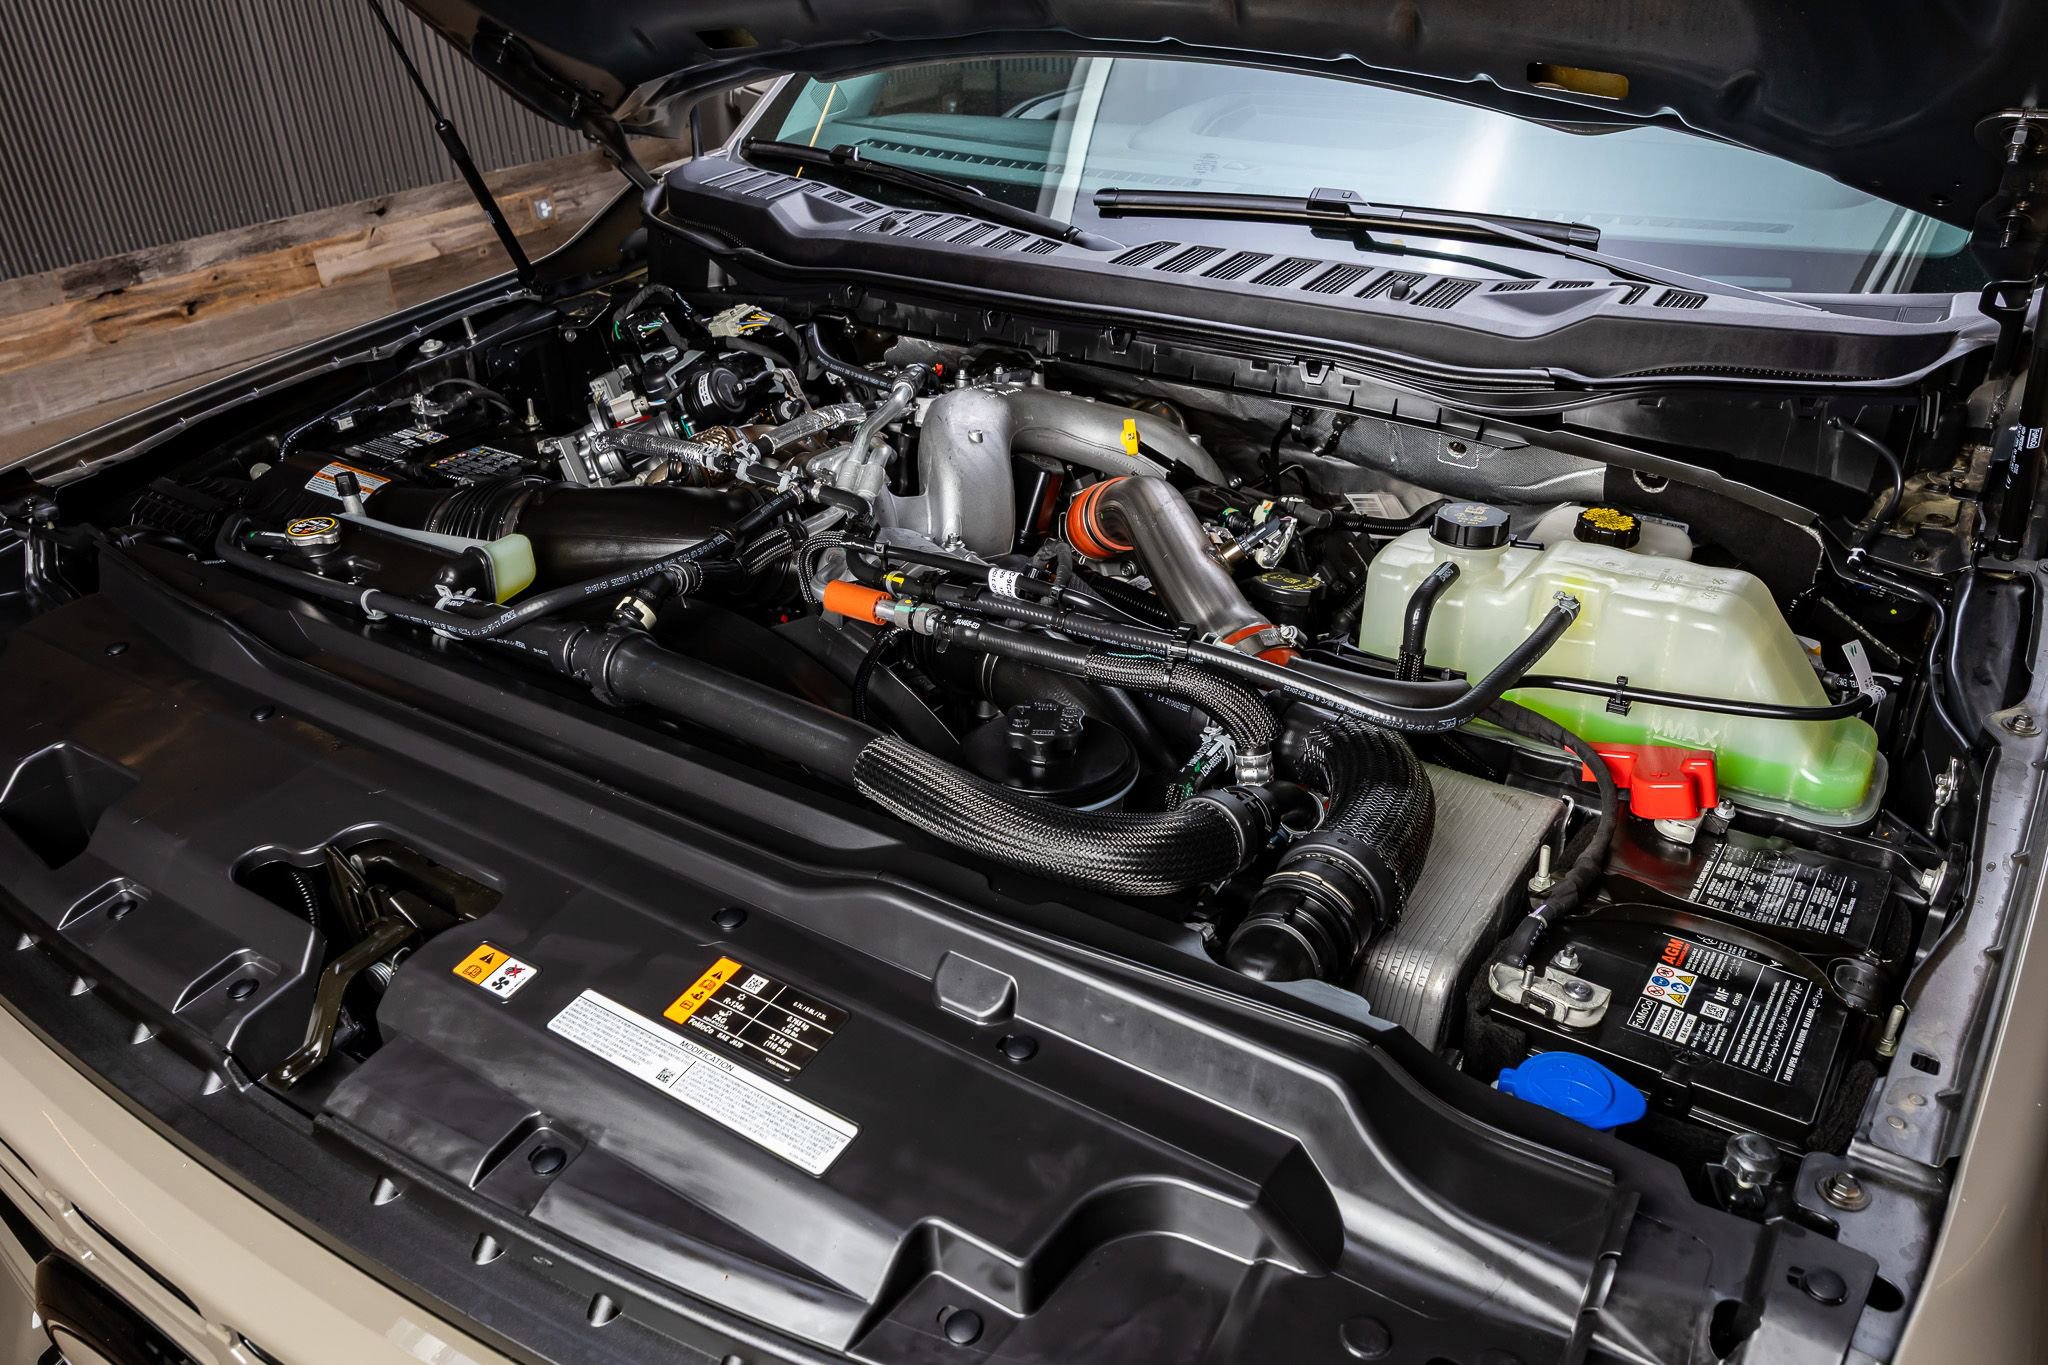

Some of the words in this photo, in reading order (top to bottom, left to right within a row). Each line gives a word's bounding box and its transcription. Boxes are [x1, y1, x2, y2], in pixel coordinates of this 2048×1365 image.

[1663, 719, 1720, 748] MAX
[1661, 937, 1685, 965] AGM
[1713, 986, 1731, 1003] MF
[687, 1018, 715, 1036] FoMoCo
[1631, 998, 1654, 1029] FoMoCo
[679, 1040, 735, 1072] MODIFICATION
